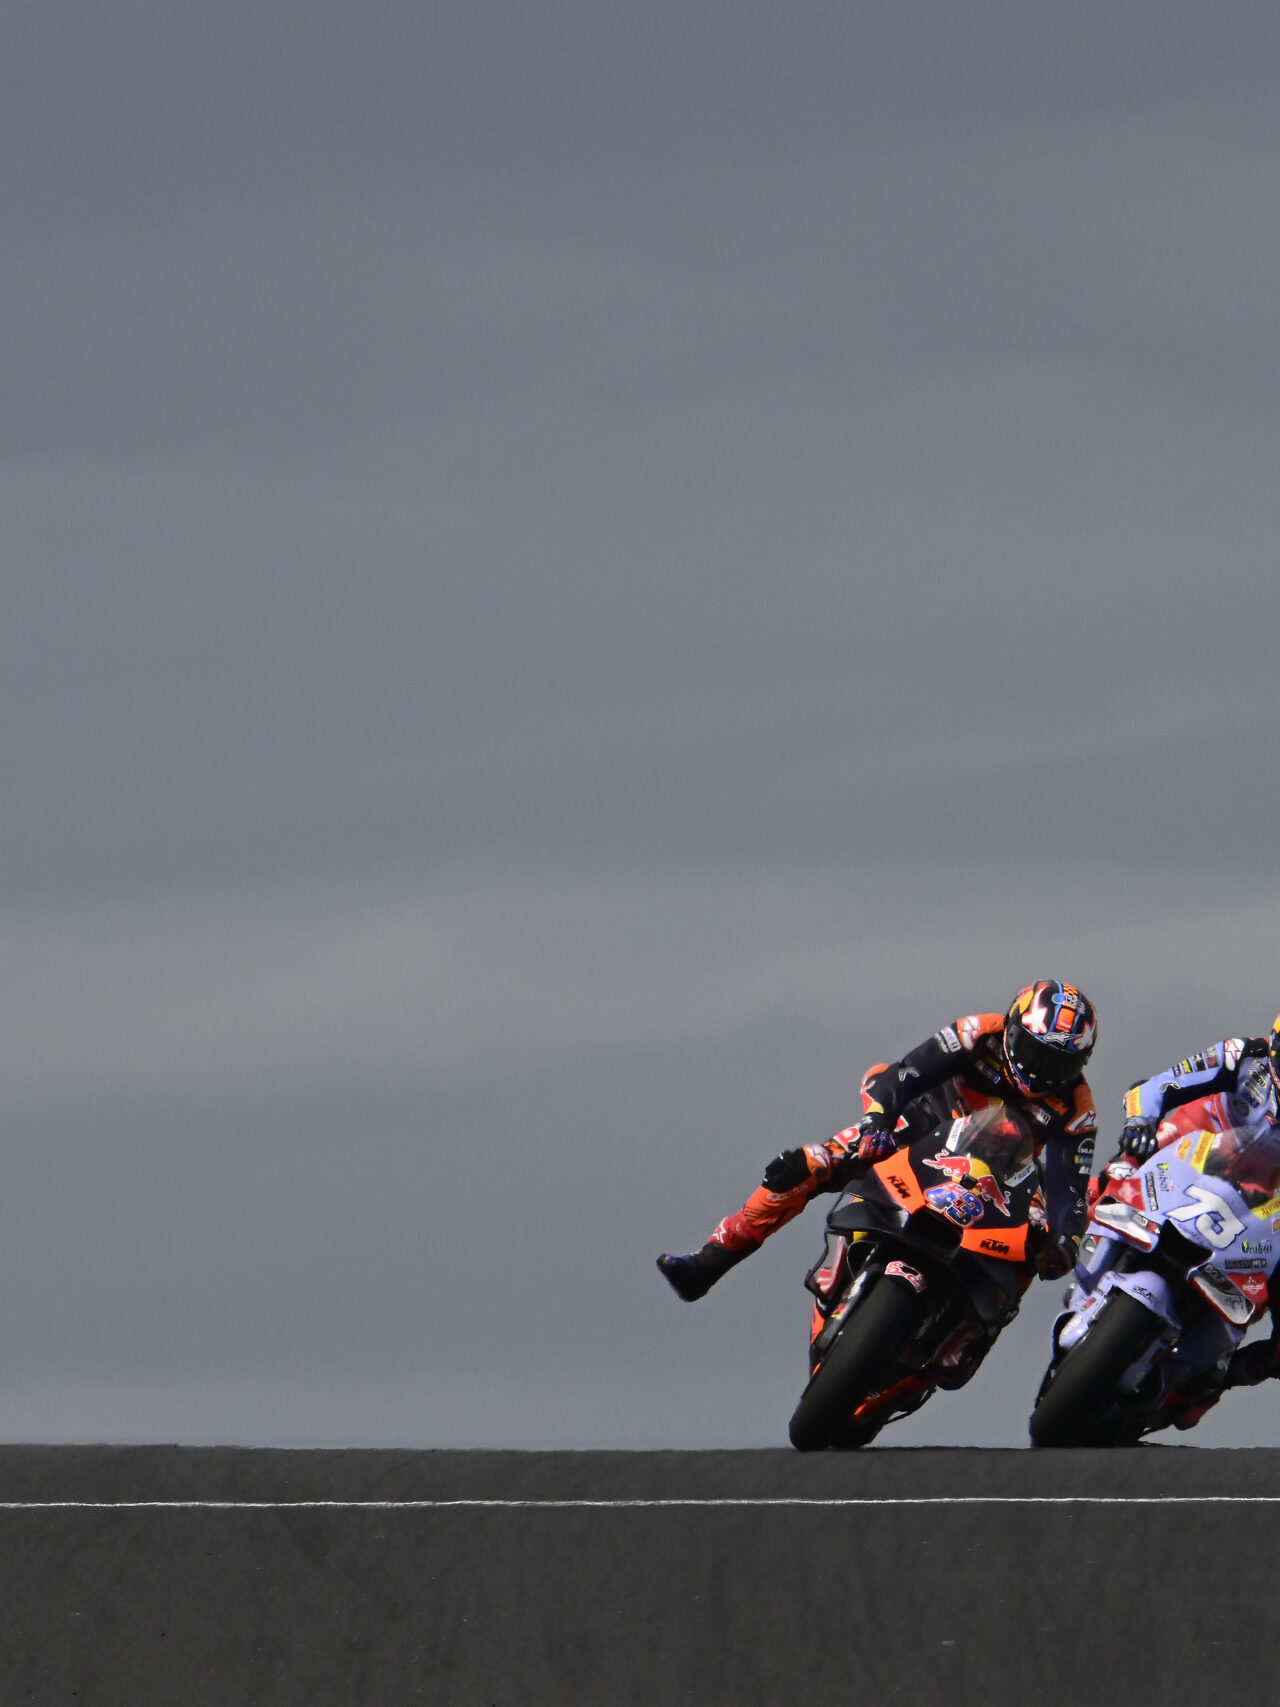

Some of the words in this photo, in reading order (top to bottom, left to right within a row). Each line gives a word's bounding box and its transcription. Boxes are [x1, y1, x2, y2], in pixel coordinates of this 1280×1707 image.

[887, 1176, 911, 1199] KTM
[924, 1181, 985, 1229] 43
[1161, 1183, 1249, 1251] 73
[980, 1238, 1010, 1255] KTM
